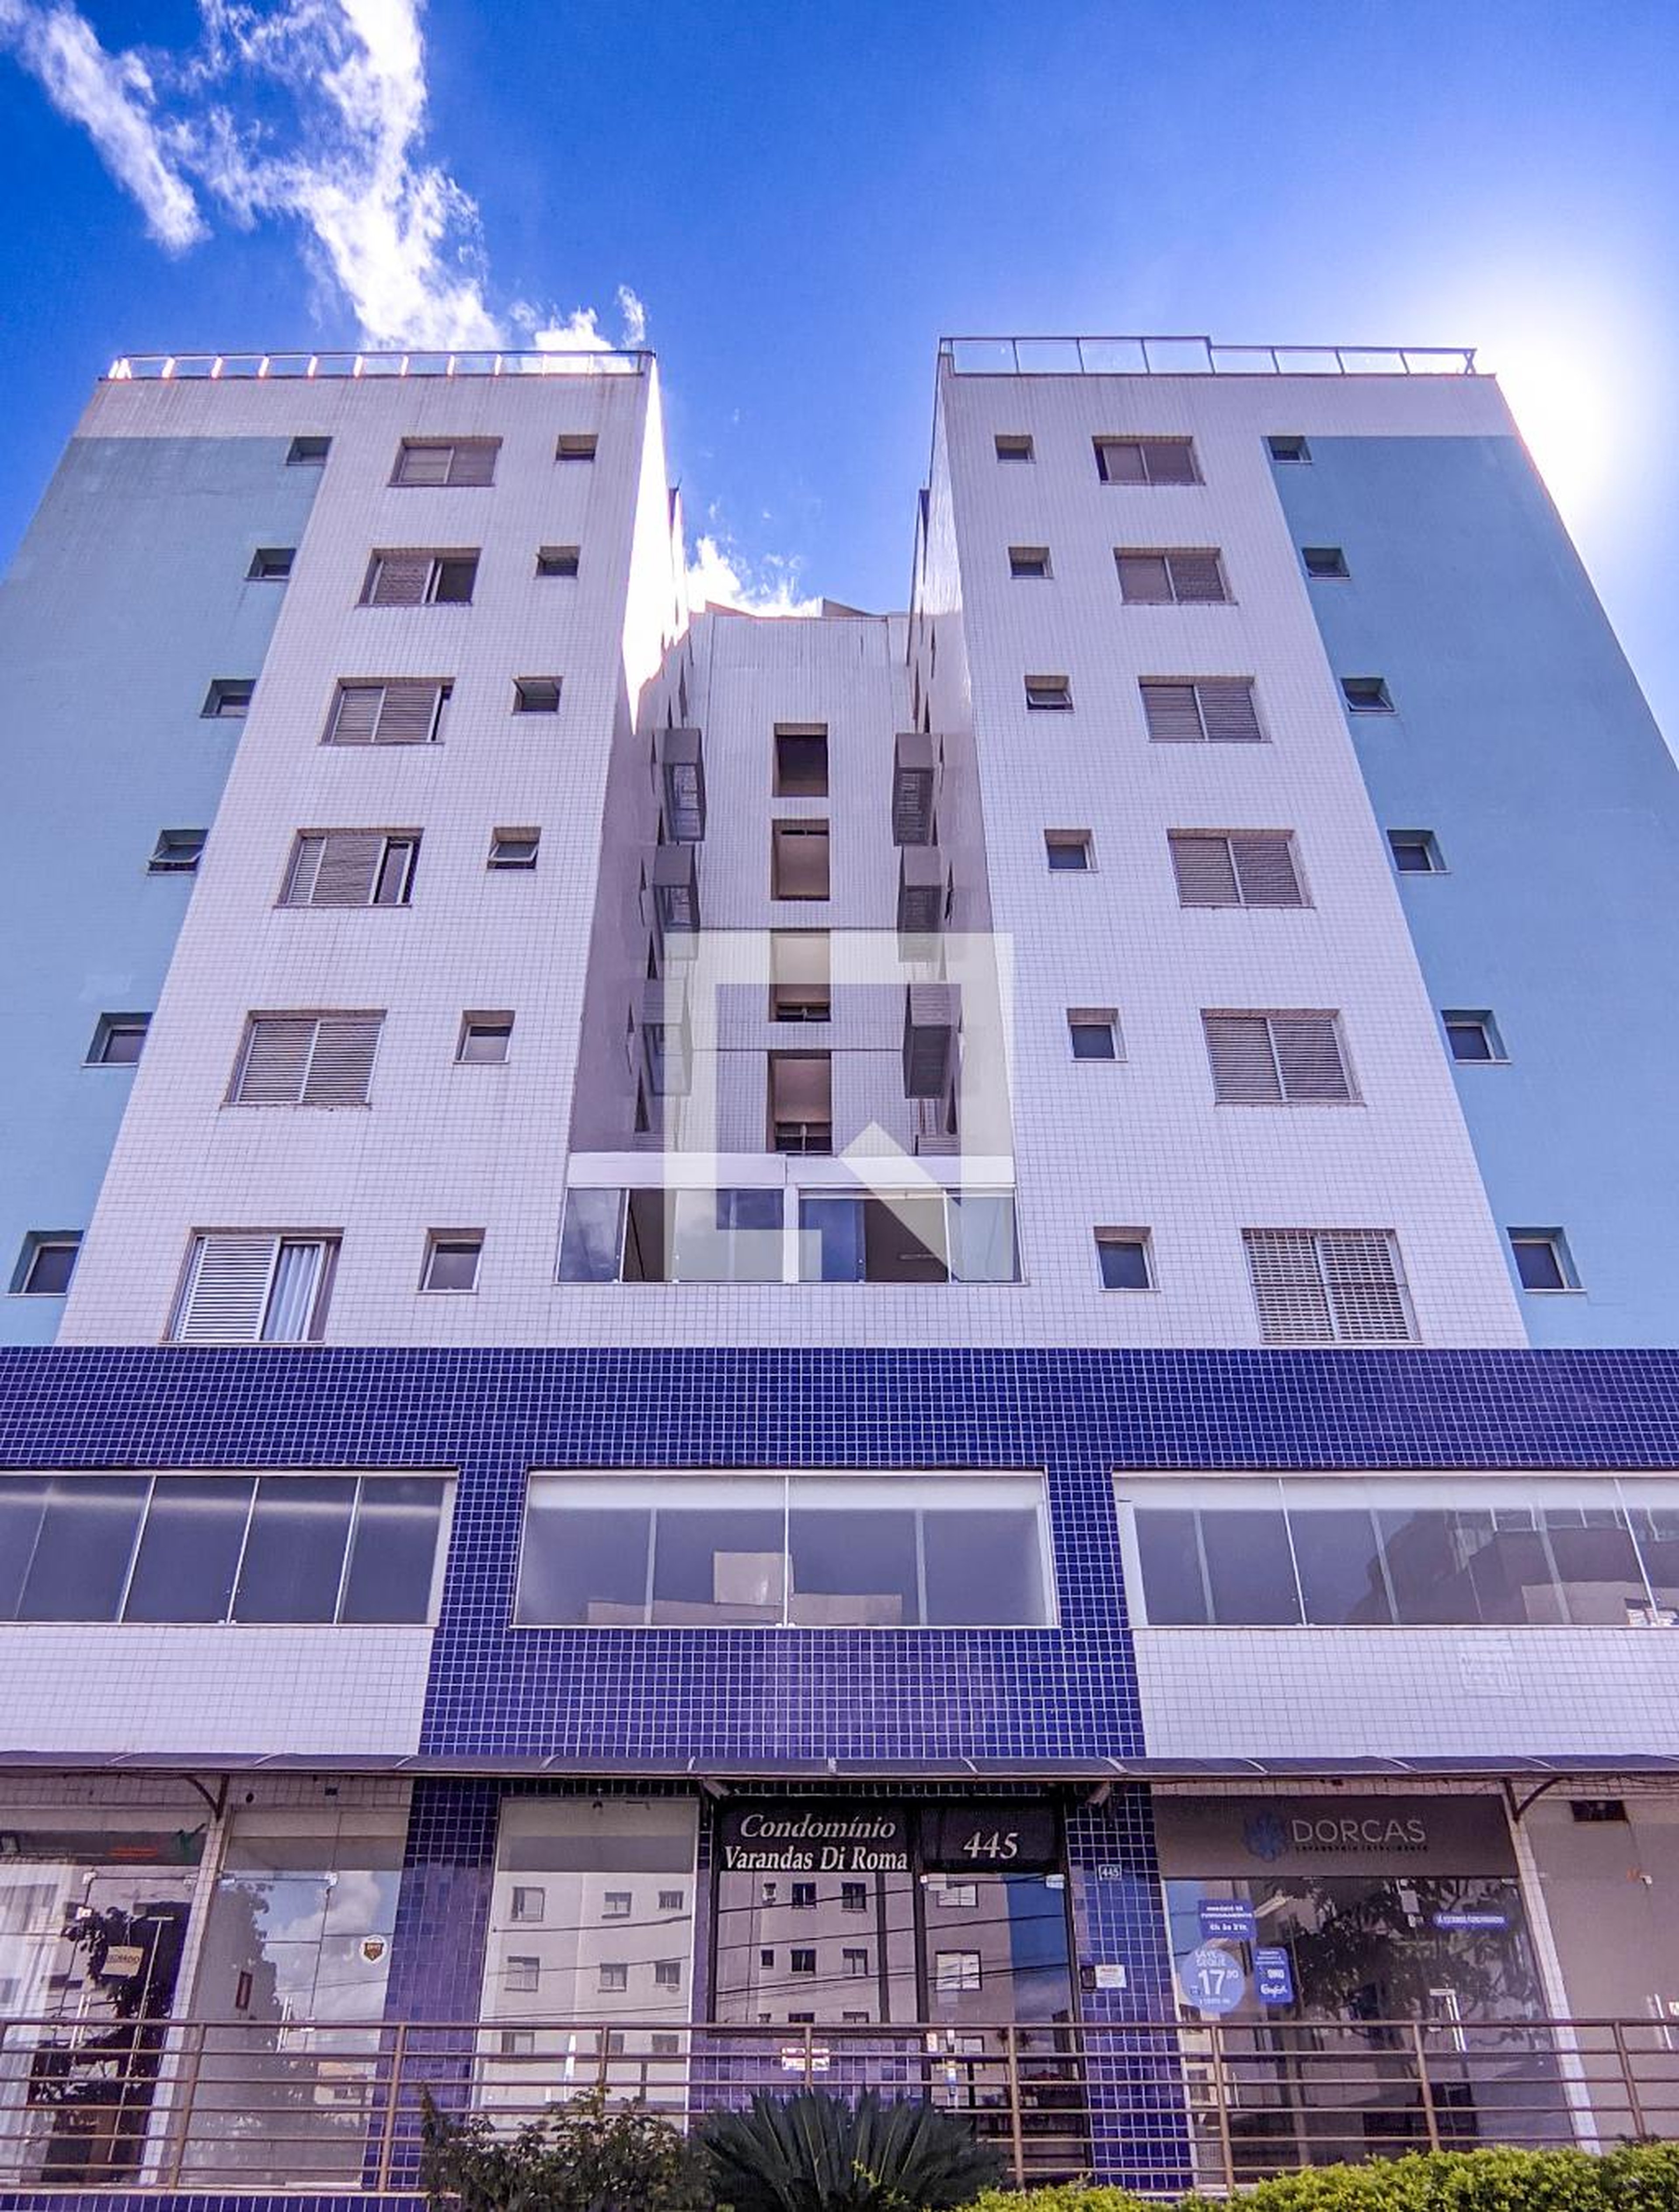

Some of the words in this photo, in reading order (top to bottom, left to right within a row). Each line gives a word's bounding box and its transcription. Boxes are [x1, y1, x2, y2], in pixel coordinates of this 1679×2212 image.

[740, 1813, 896, 1838] Condomínio
[1292, 1819, 1426, 1843] DORCAS
[725, 1845, 814, 1870] Varandas
[819, 1846, 846, 1870] Di
[850, 1846, 908, 1870] Roma
[963, 1831, 1019, 1860] 445
[1101, 1867, 1119, 1877] 445
[1198, 1969, 1225, 1995] 17
